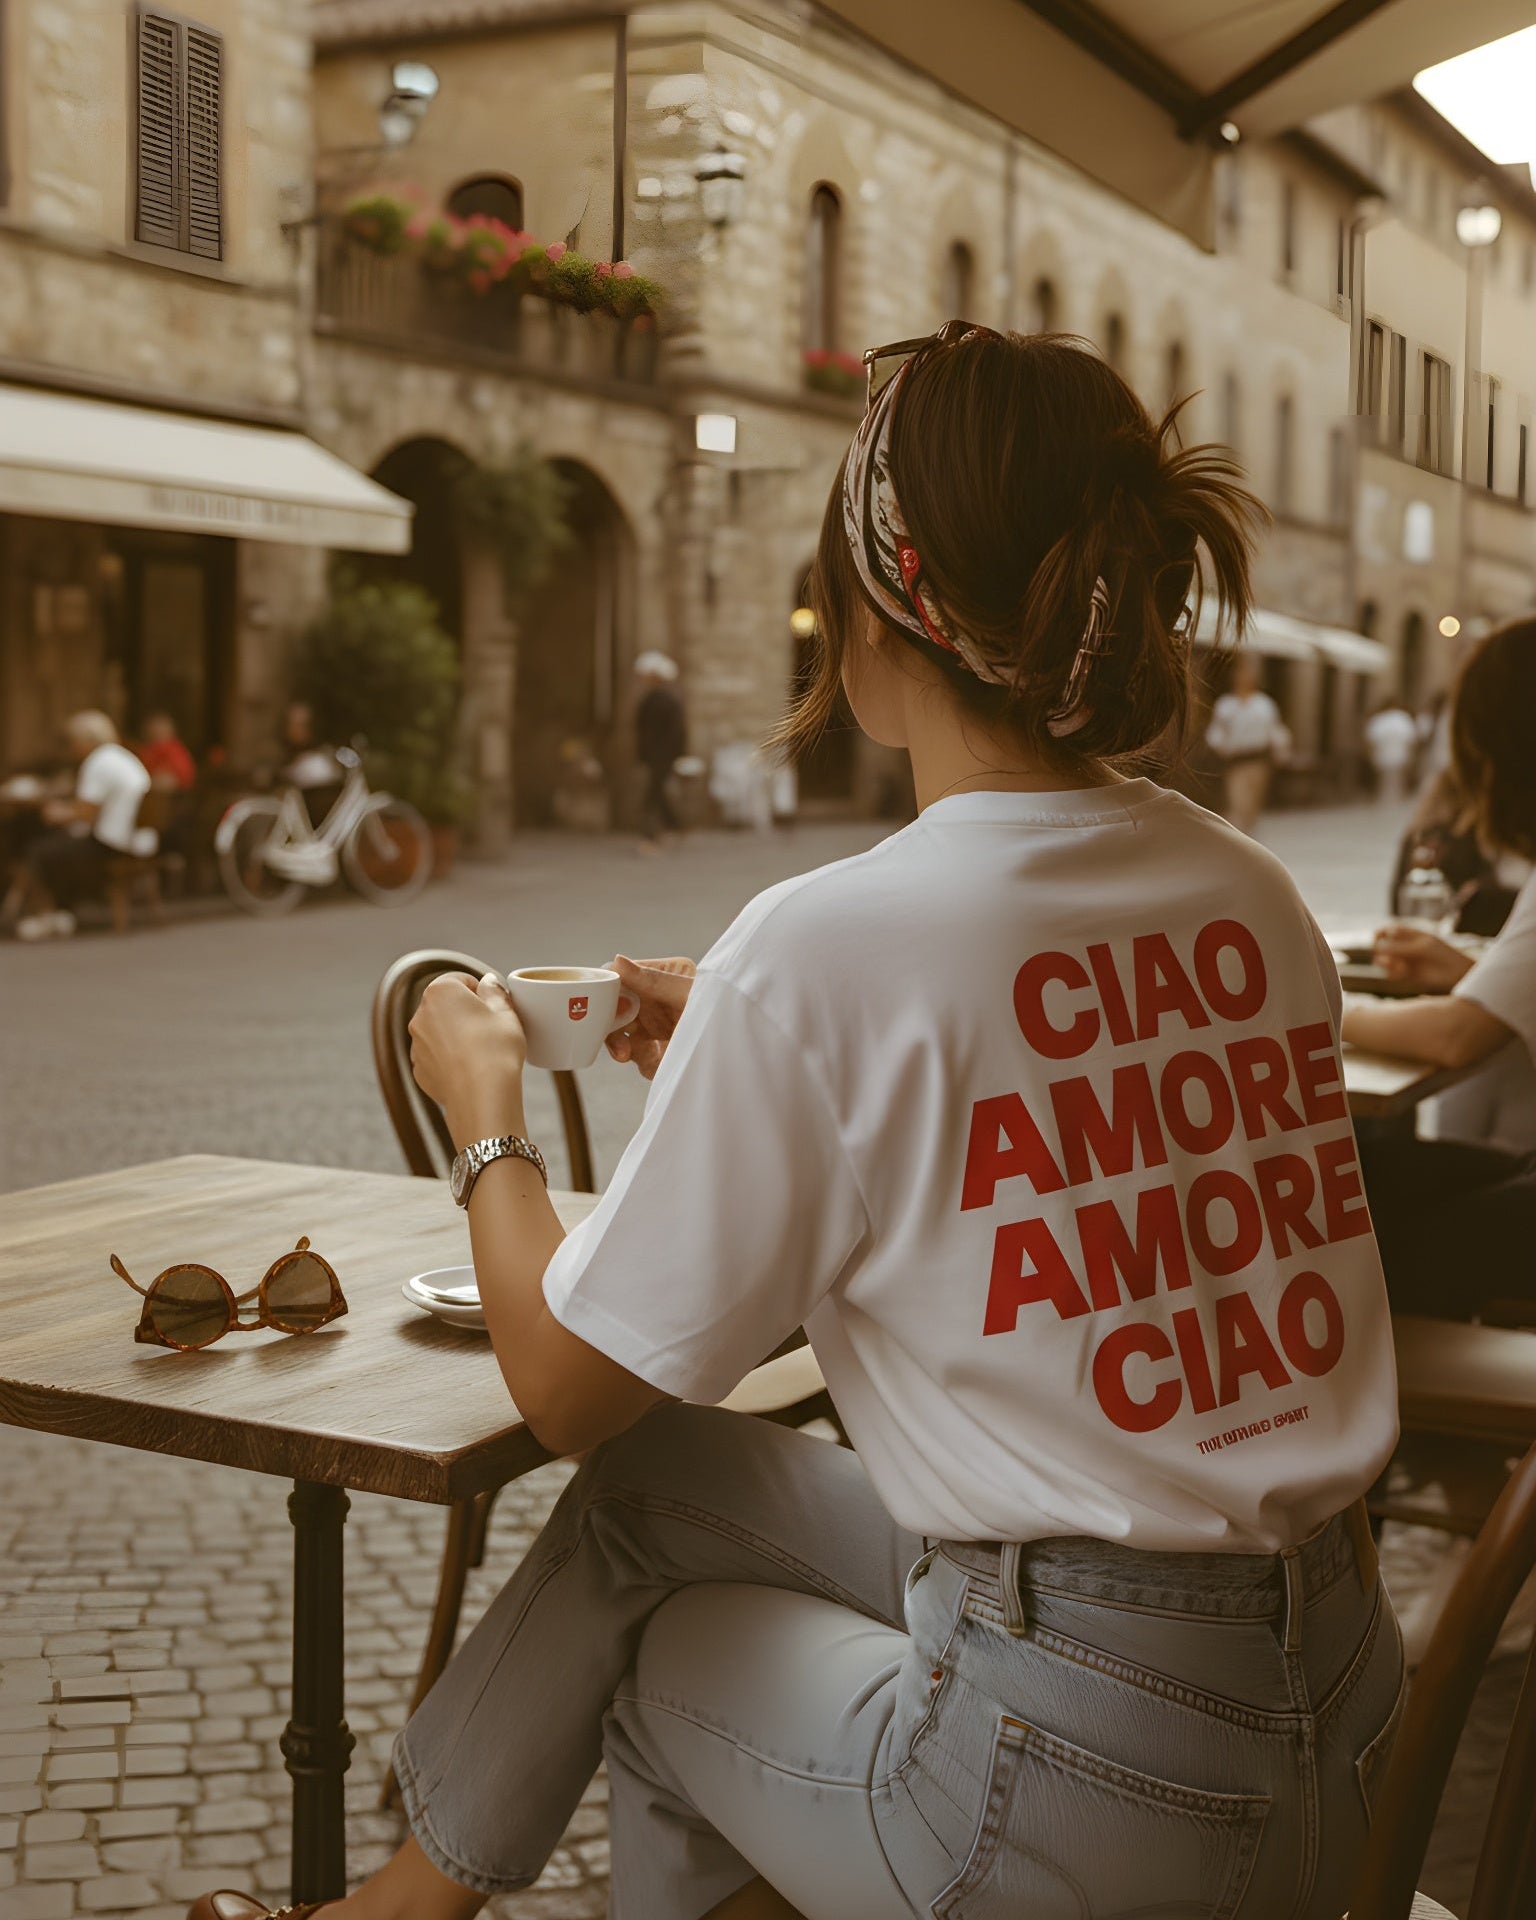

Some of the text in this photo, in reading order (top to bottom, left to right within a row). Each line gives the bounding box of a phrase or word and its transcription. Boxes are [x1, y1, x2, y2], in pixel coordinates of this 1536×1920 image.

[1013, 919, 1267, 1060] CIAO
[960, 1021, 1347, 1212] AMORE
[982, 1136, 1372, 1336] AMORE
[1092, 1271, 1345, 1433] CIAO
